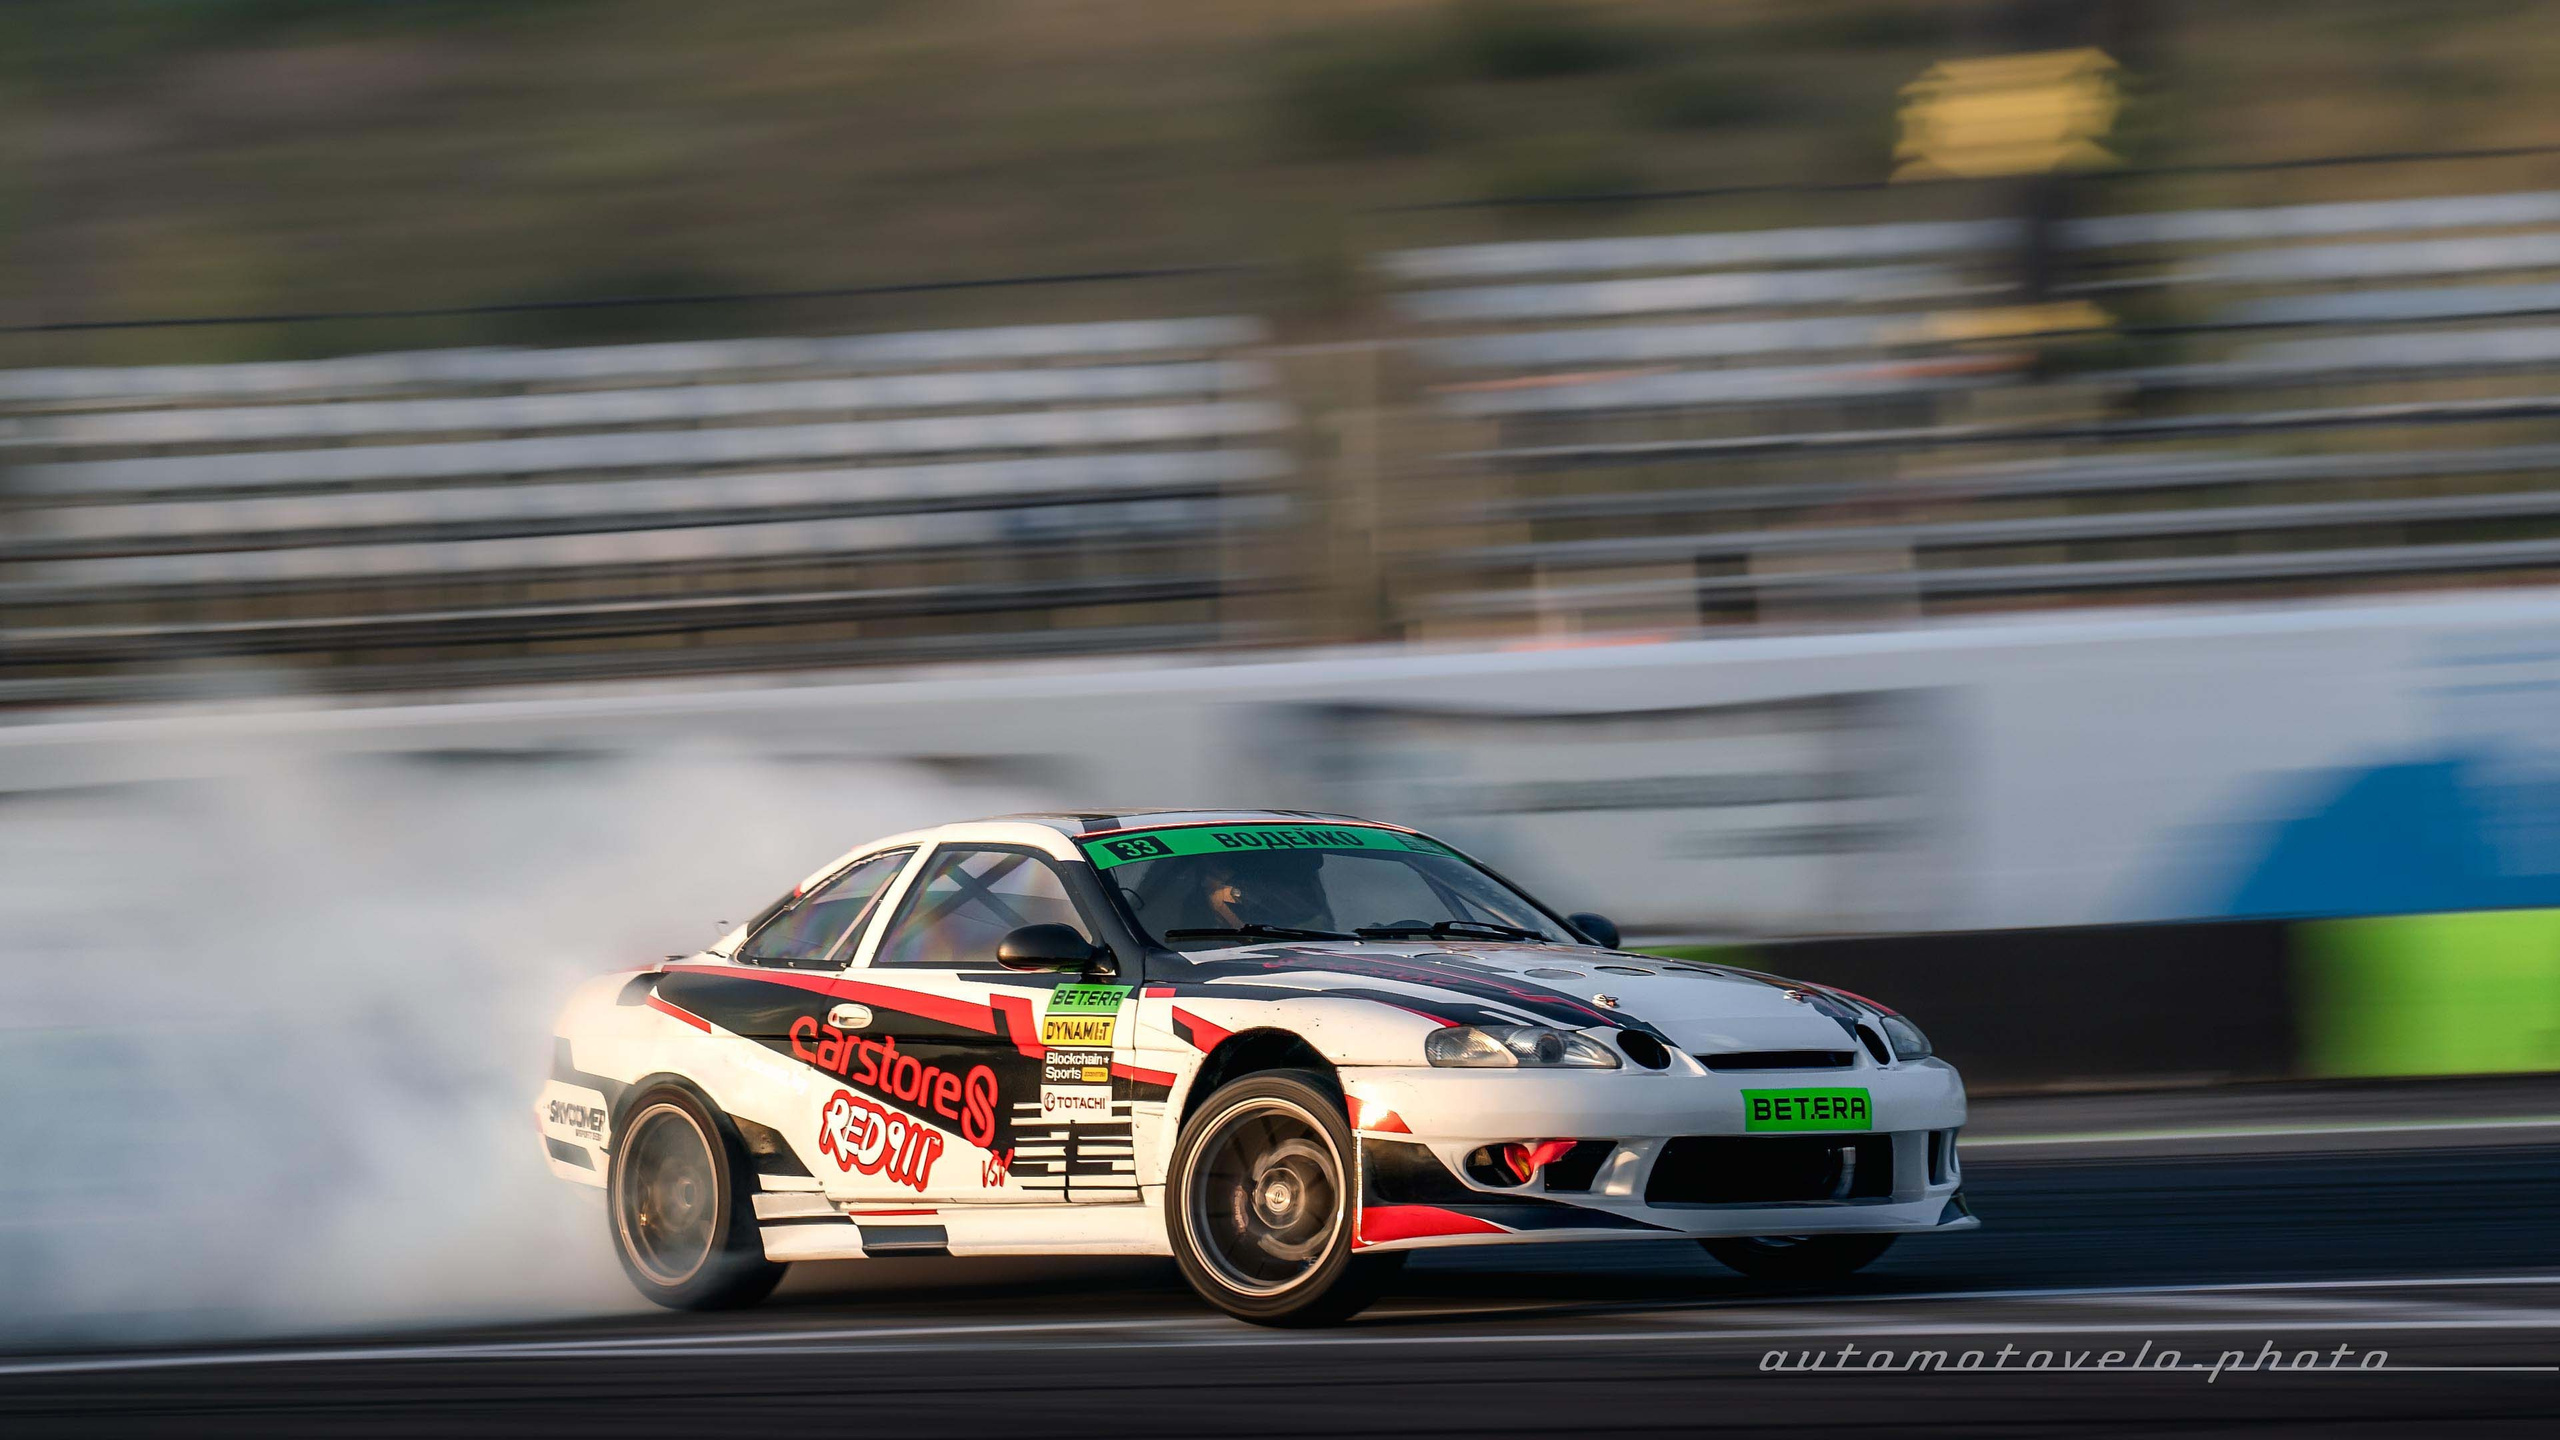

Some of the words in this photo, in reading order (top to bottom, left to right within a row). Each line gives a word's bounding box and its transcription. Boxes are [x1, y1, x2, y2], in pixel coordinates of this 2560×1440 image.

[1211, 827, 1365, 851] ВОДЕЙКО
[1117, 839, 1159, 857] 33
[1046, 1052, 1103, 1066] Blockchain
[1045, 1066, 1082, 1081] Sports
[1056, 1096, 1106, 1110] TOTACHI
